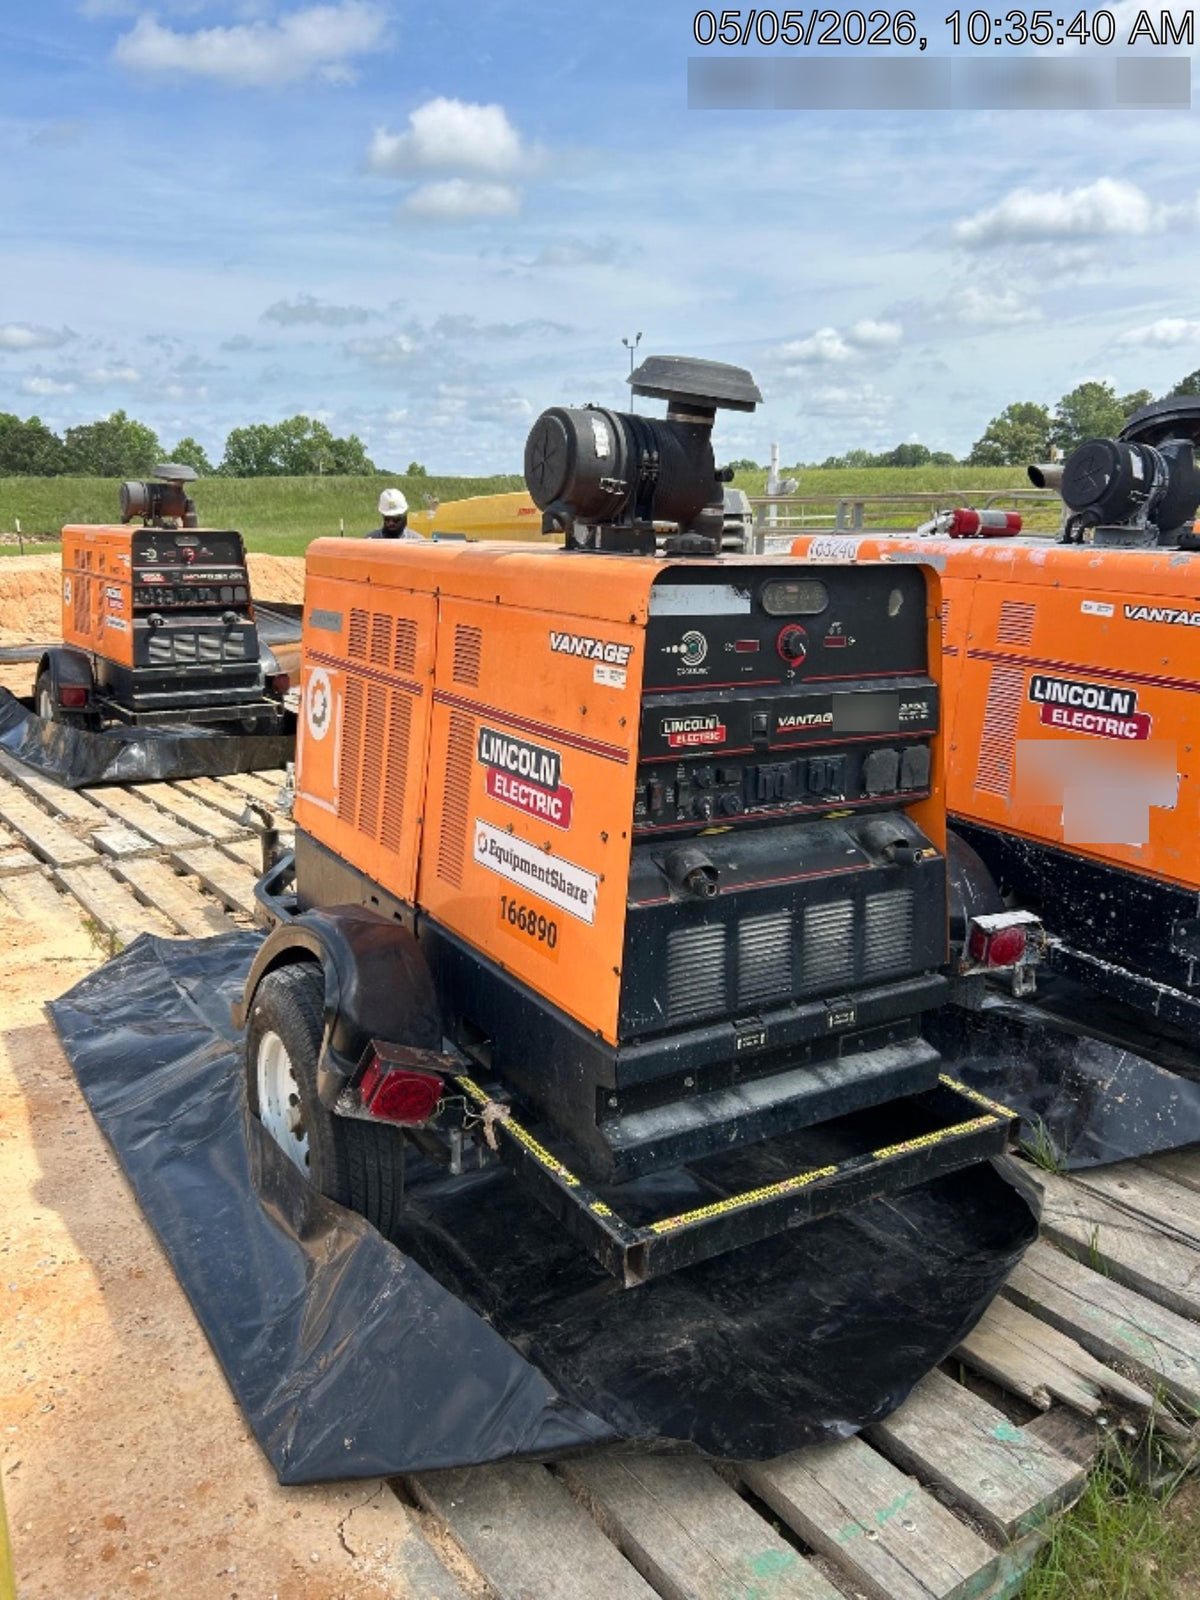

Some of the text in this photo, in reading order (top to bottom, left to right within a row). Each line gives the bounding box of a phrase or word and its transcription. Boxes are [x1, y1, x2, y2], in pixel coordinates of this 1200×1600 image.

[1123, 604, 1200, 627] VANTAG
[550, 630, 633, 667] VANTAGE
[1033, 679, 1131, 714] LINCOLN
[664, 715, 717, 734] LINCOLN
[777, 711, 833, 728] VANTAG
[1051, 708, 1139, 739] ELECTRIC
[675, 730, 721, 745] ELECTRIC
[481, 732, 556, 787] LINCOLN
[493, 772, 563, 821] ELECTRIC
[488, 838, 589, 904] EquipmentShare
[500, 895, 558, 949] 166890
